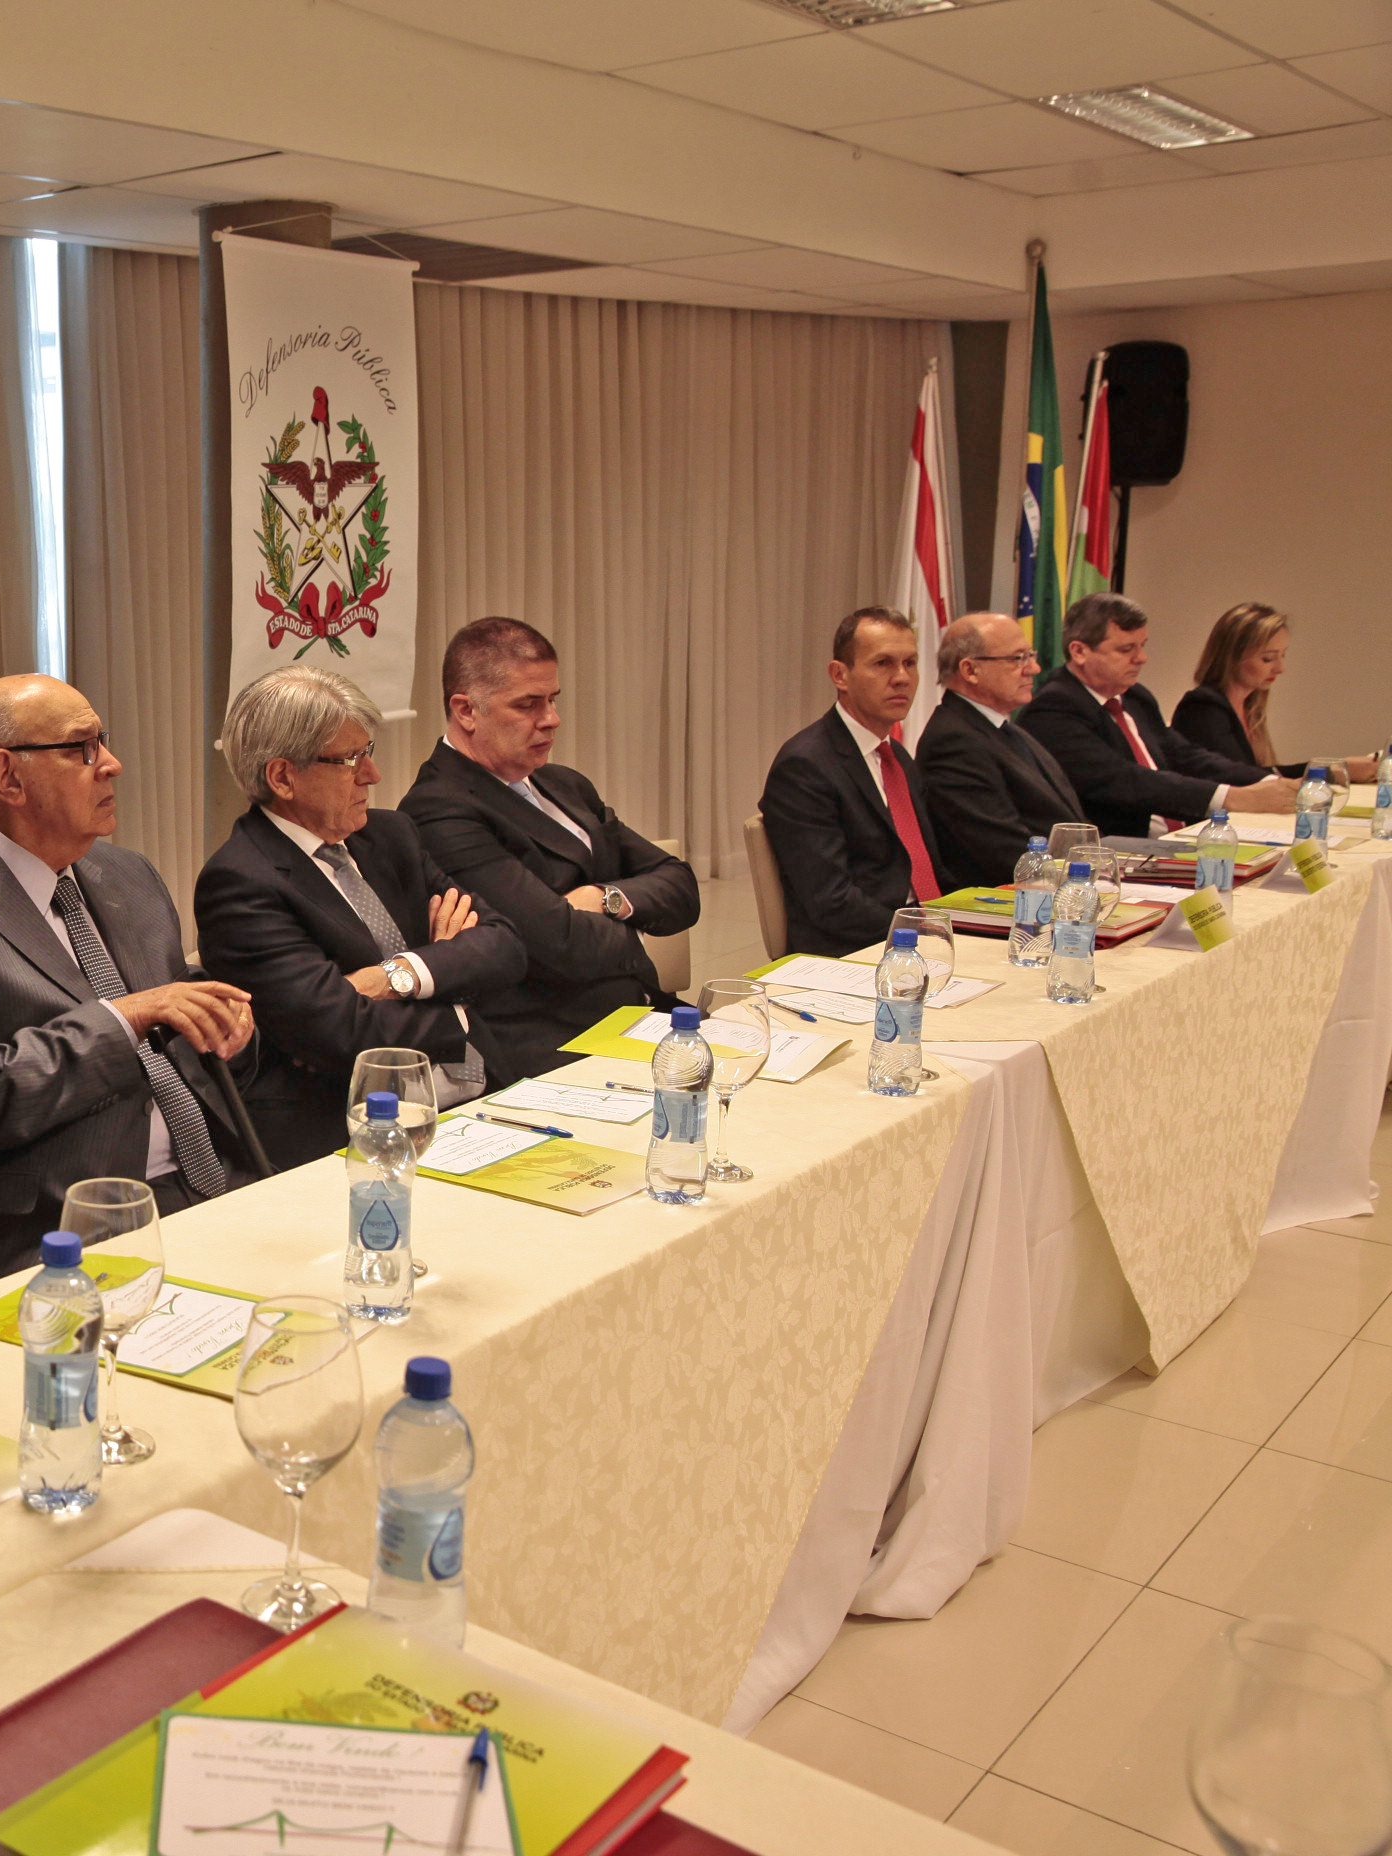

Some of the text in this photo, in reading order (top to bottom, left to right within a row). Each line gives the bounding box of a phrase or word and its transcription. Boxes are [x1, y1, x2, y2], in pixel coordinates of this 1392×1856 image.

[239, 324, 397, 418] Defensoria Pública
[269, 615, 300, 633] ESTADO
[300, 624, 312, 637] DE
